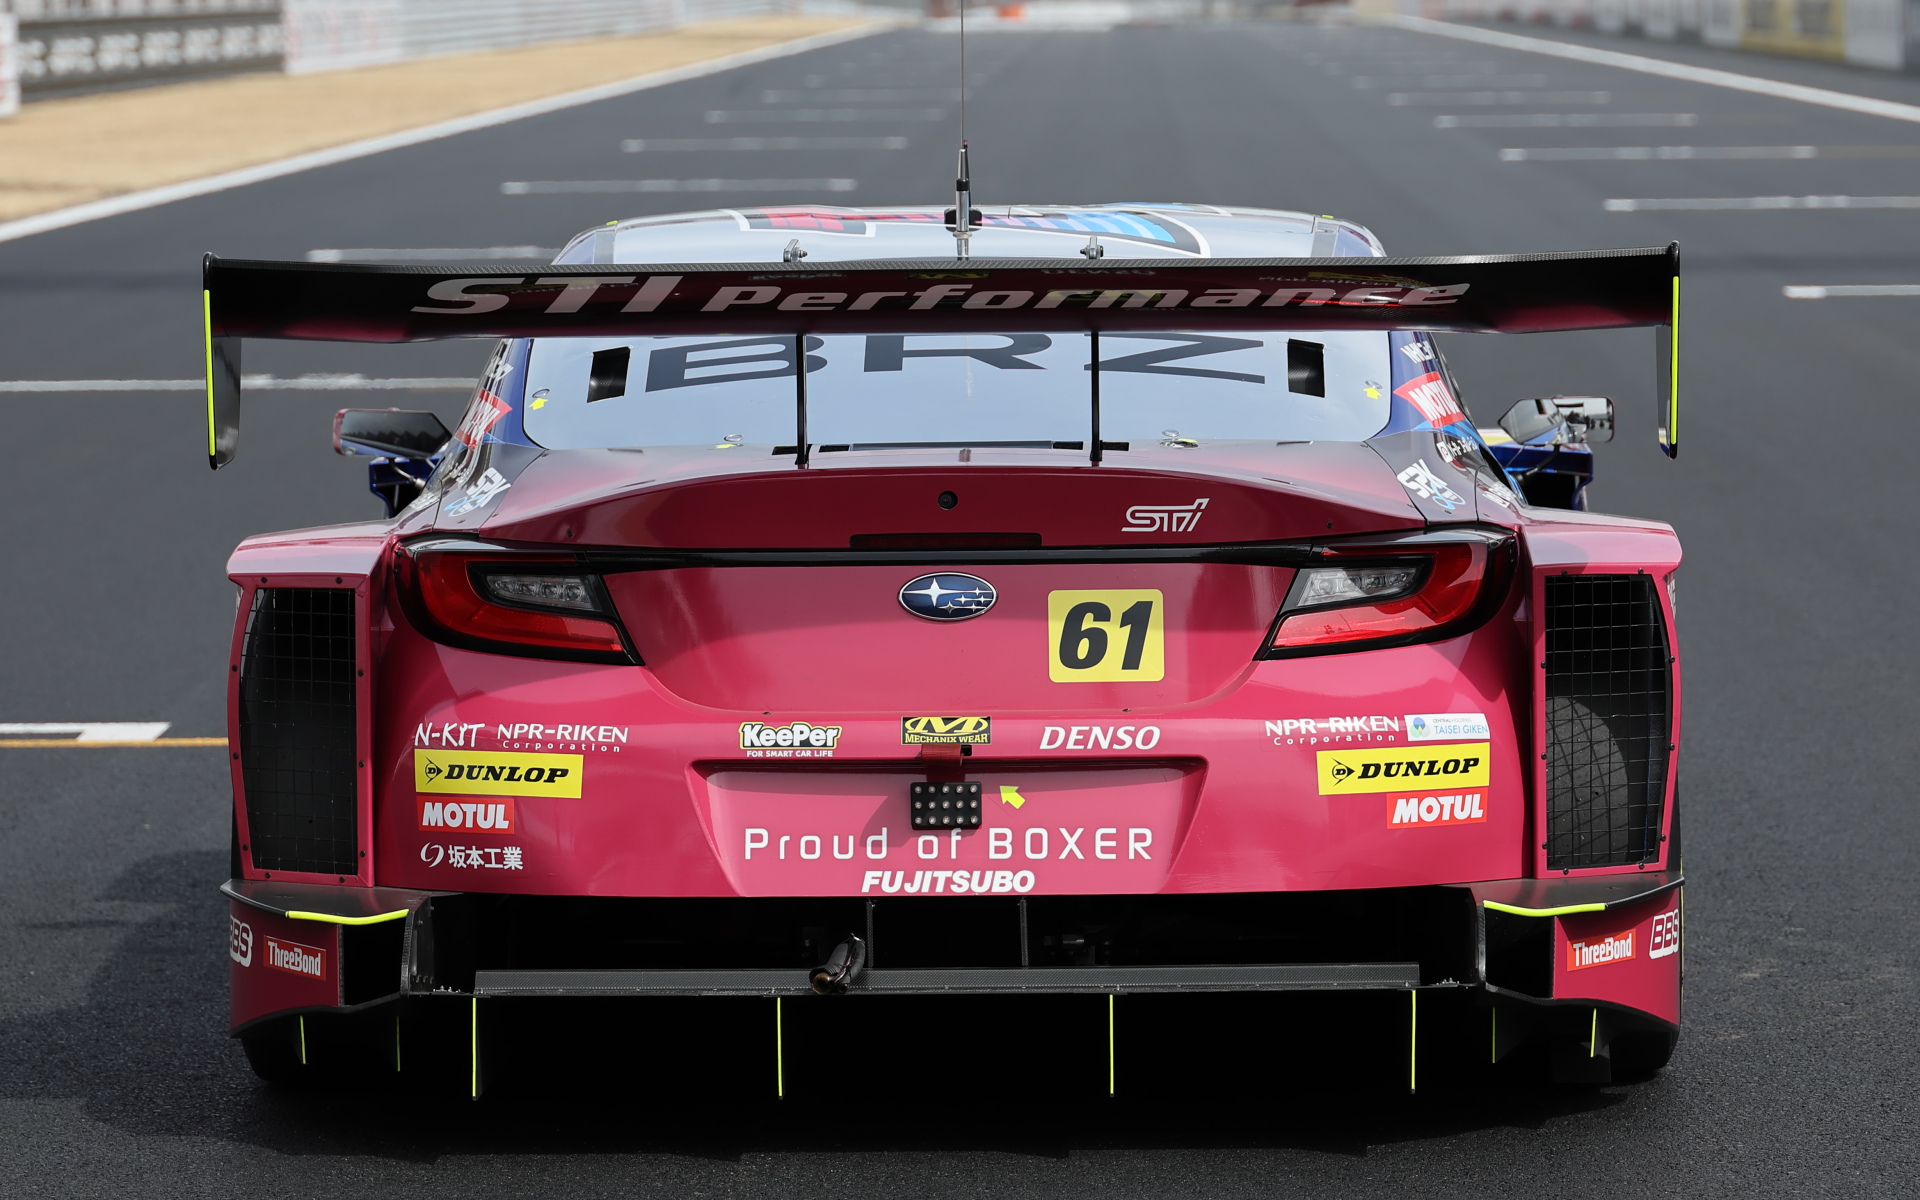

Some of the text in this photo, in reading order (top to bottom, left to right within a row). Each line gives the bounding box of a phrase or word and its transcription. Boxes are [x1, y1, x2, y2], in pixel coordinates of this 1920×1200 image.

[410, 276, 1471, 315] STI Performance
[645, 335, 1265, 392] BRZ
[1058, 600, 1153, 670] 61
[497, 723, 629, 743] NPR-RIKEN
[742, 723, 839, 747] KeePer
[905, 733, 989, 743] MECHANIX WEAR
[1039, 726, 1161, 750] DENSO
[1265, 716, 1399, 737] NPR-RIKEN
[1434, 724, 1488, 734] TAISEI GIKEN
[503, 740, 621, 753] Corporation
[1273, 734, 1395, 746] Corporation
[444, 763, 569, 784] DUNLOP
[1358, 757, 1480, 779] DUNLOP
[422, 802, 509, 829] MOTUL
[1392, 794, 1483, 824] MOTUL
[745, 827, 1153, 860] Proud of BOXER
[448, 844, 524, 871] 坂本工業
[861, 870, 1035, 894] FUJITSUBO
[1649, 909, 1679, 959] BBS
[268, 941, 321, 976] ThreeBond
[1573, 933, 1632, 967] ThreeBond
